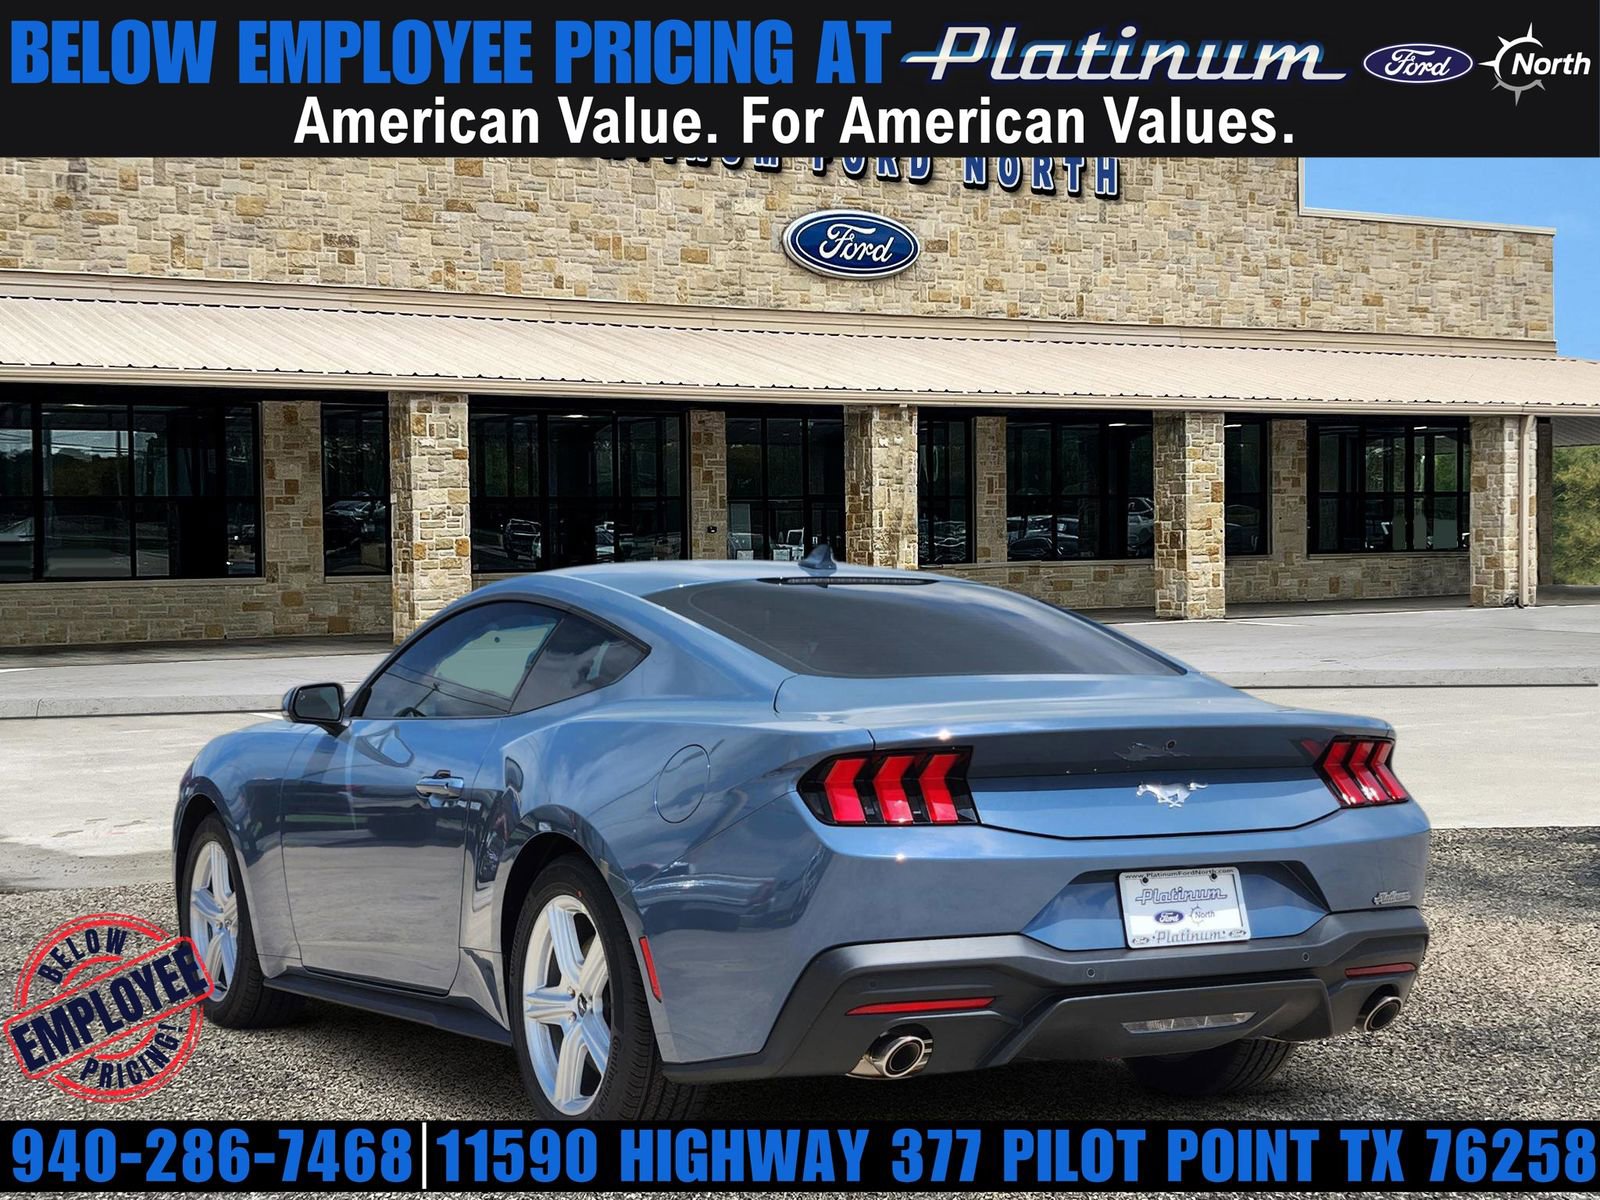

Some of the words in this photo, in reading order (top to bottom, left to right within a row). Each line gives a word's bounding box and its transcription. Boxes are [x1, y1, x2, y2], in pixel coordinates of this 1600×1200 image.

[963, 157, 1119, 196] NORTH
[819, 223, 895, 263] Ford
[1135, 886, 1228, 906] Platinum
[1194, 909, 1215, 920] North
[1155, 927, 1225, 944] Platinum
